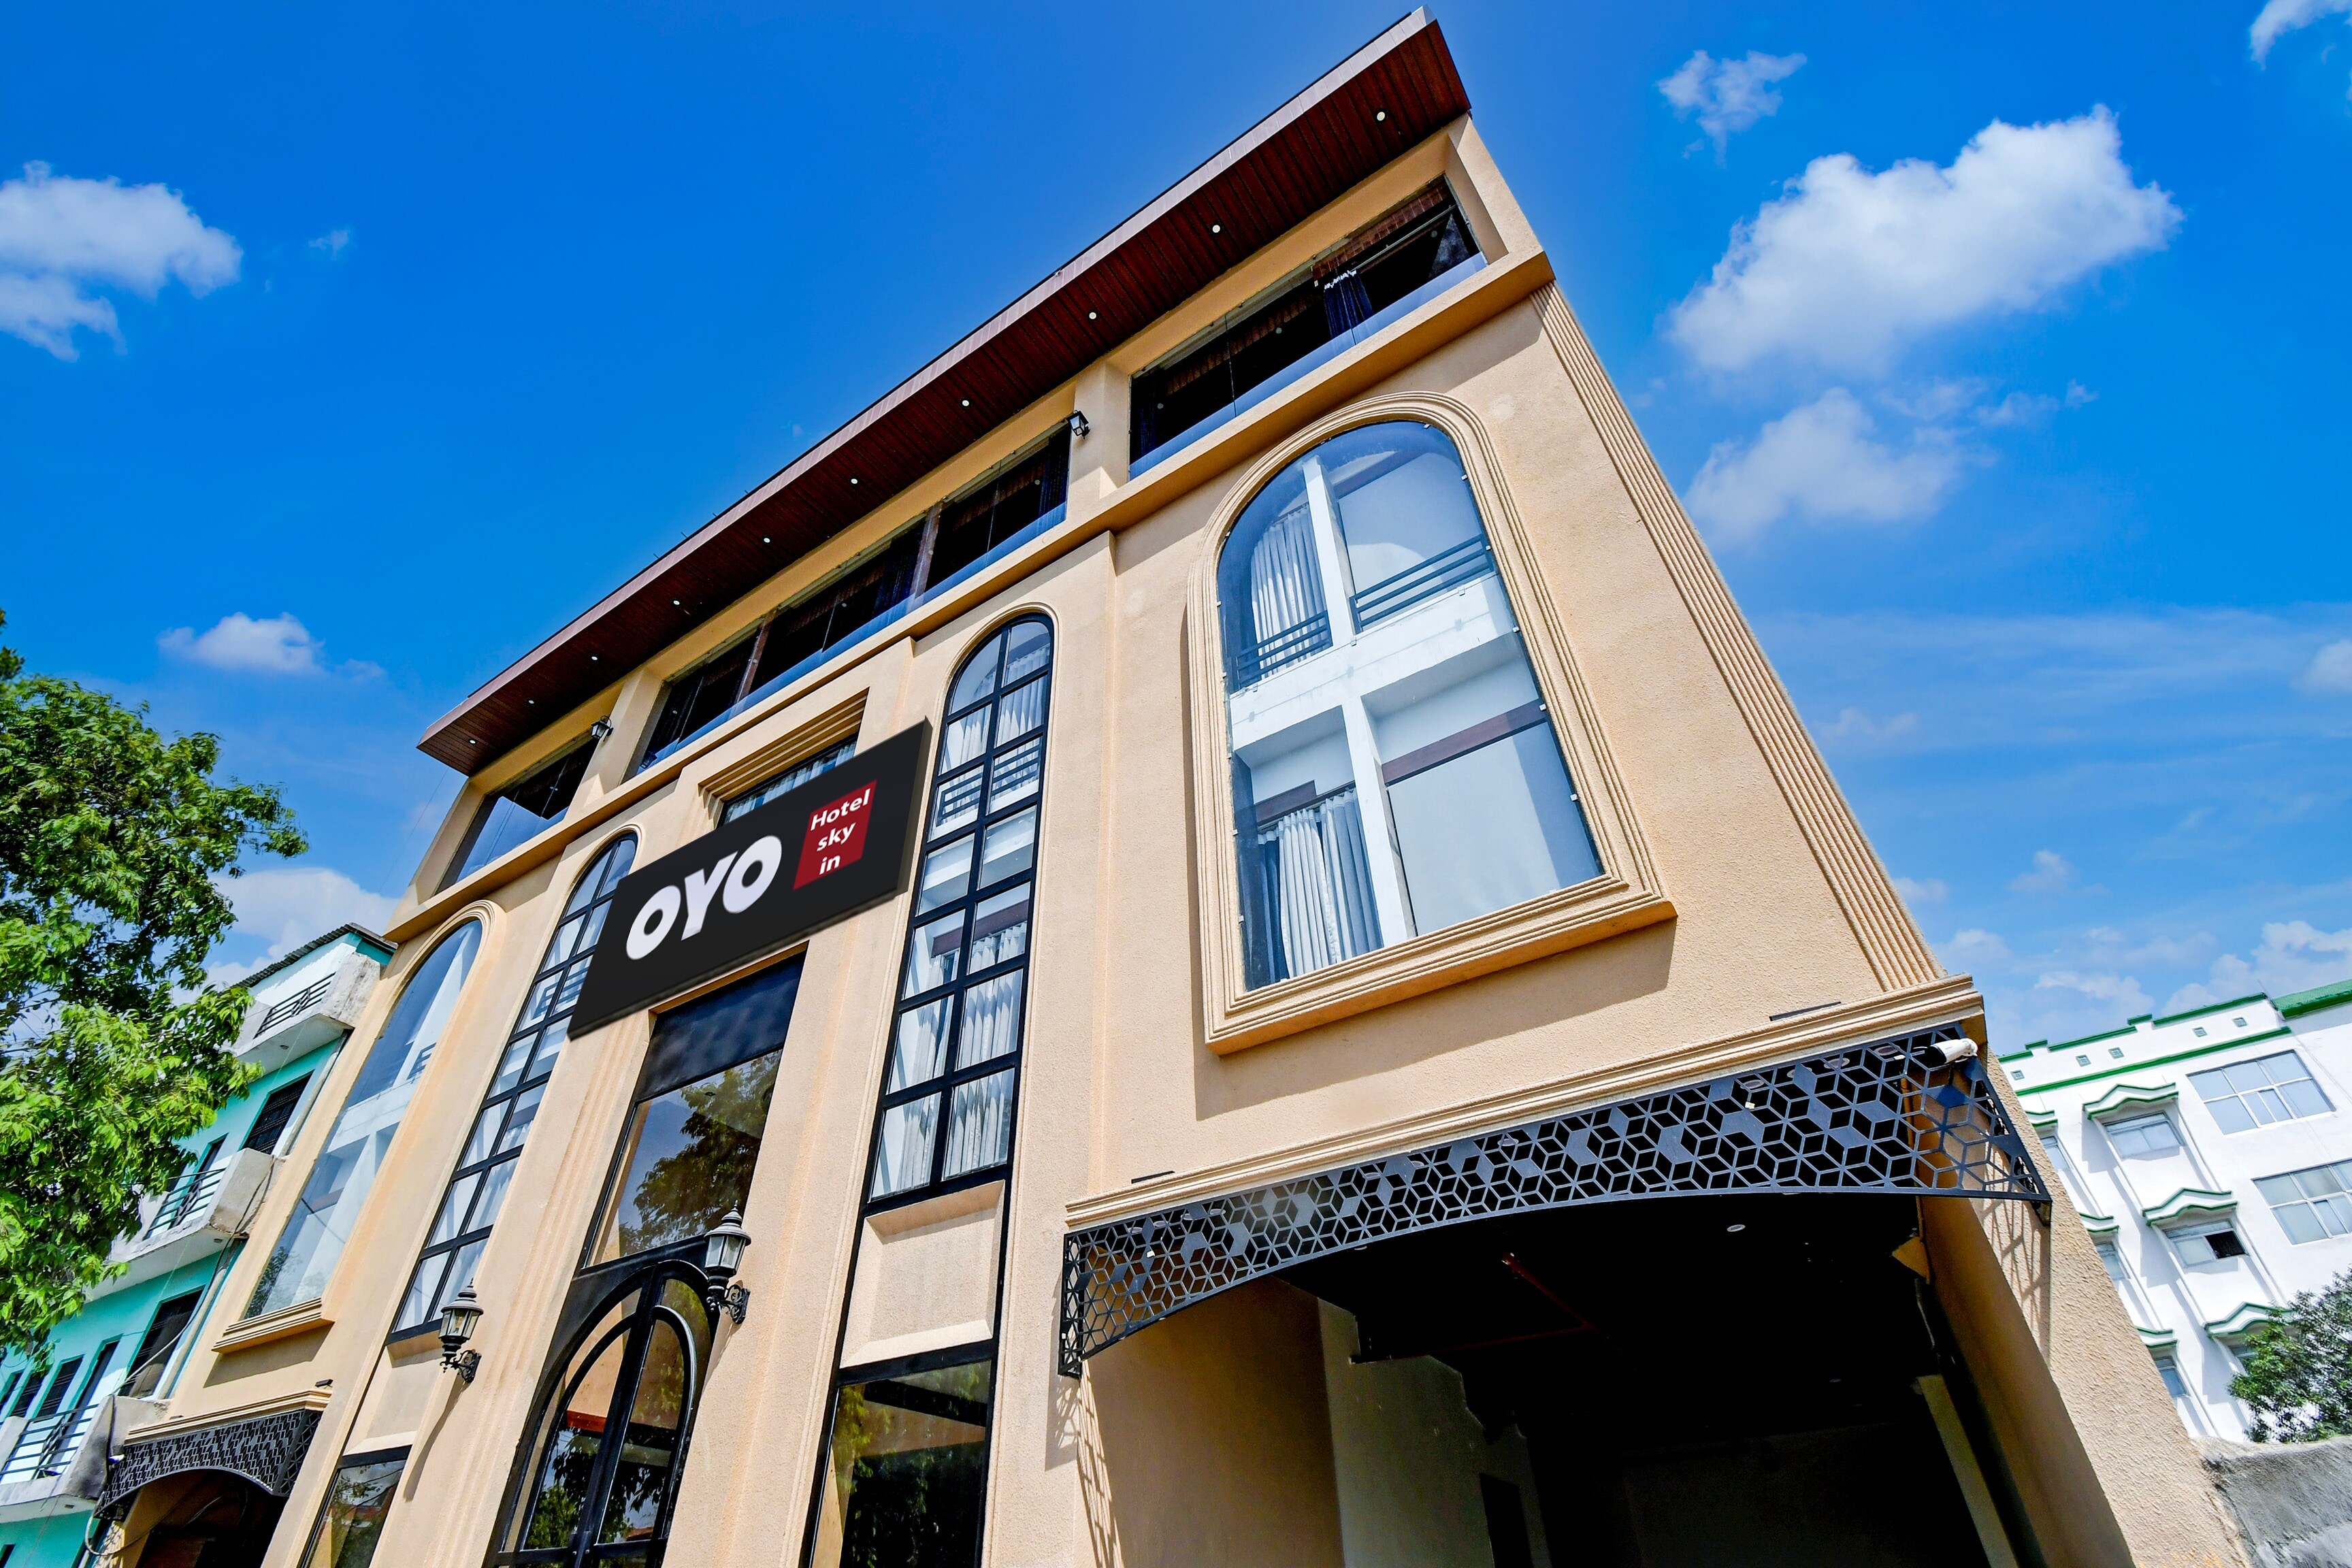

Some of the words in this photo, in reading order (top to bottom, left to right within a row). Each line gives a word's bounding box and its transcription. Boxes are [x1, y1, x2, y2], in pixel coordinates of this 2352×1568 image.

[810, 788, 870, 831] Hotel
[817, 821, 856, 852] sky
[819, 855, 840, 875] in
[625, 835, 782, 960] OYO
